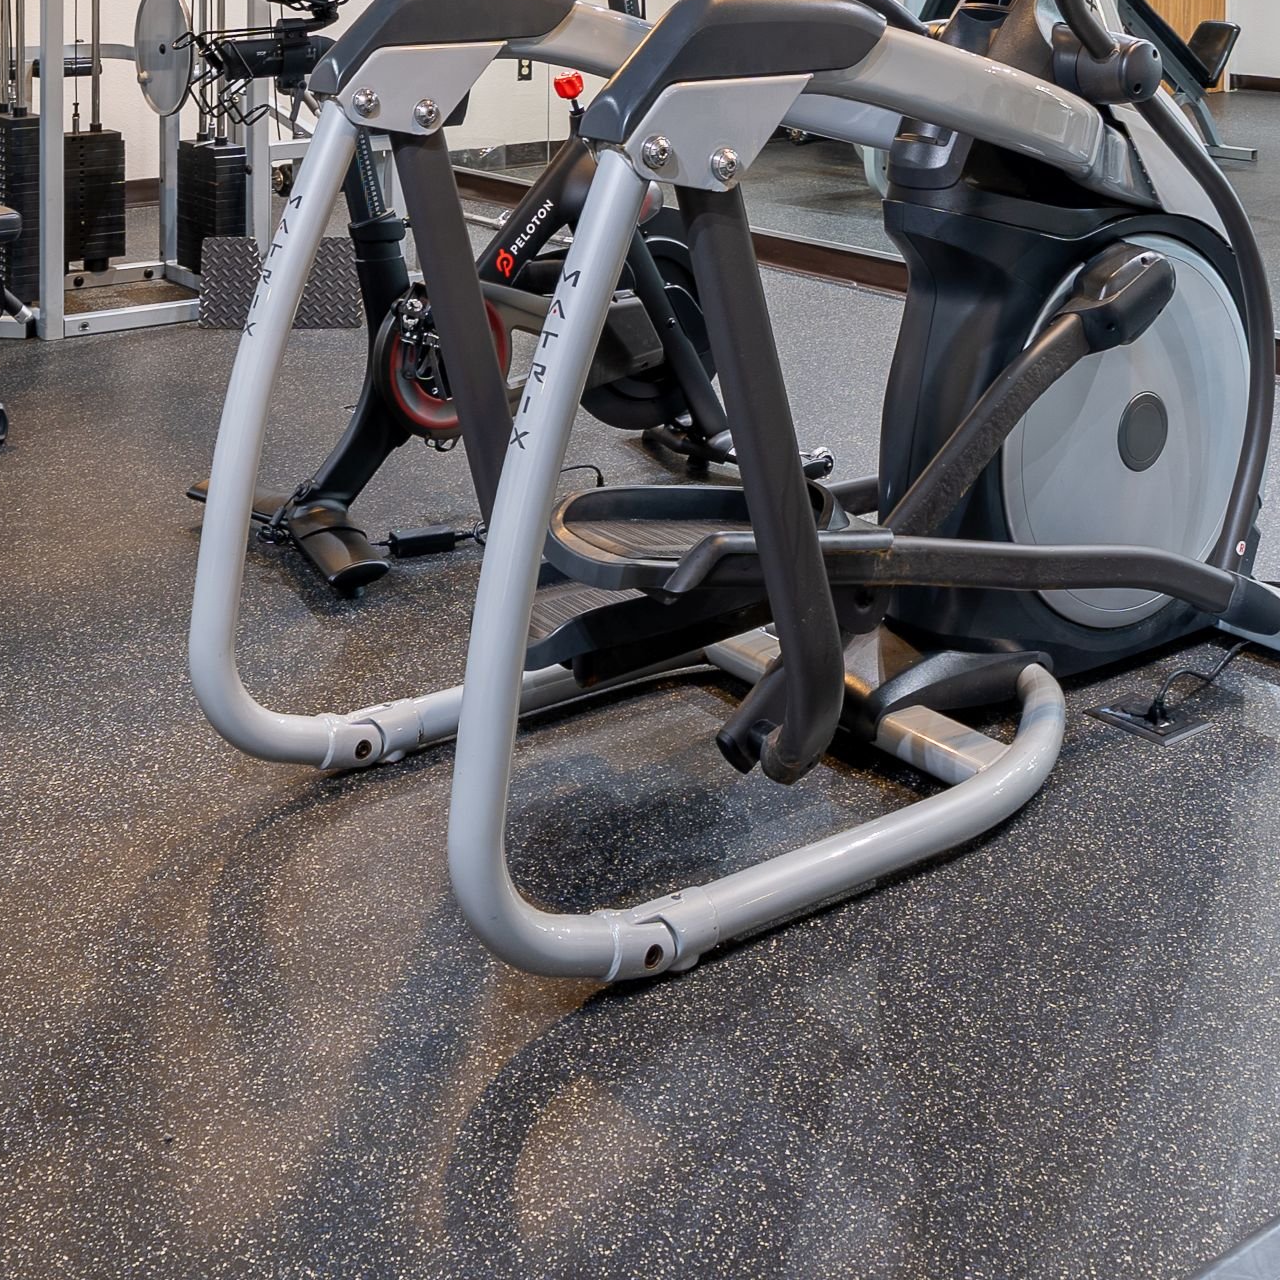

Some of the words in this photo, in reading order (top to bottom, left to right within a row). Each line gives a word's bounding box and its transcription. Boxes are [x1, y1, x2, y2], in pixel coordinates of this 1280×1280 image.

[242, 195, 303, 337] MATRIX
[510, 199, 555, 256] PELOTON
[510, 269, 581, 450] MATRIX
